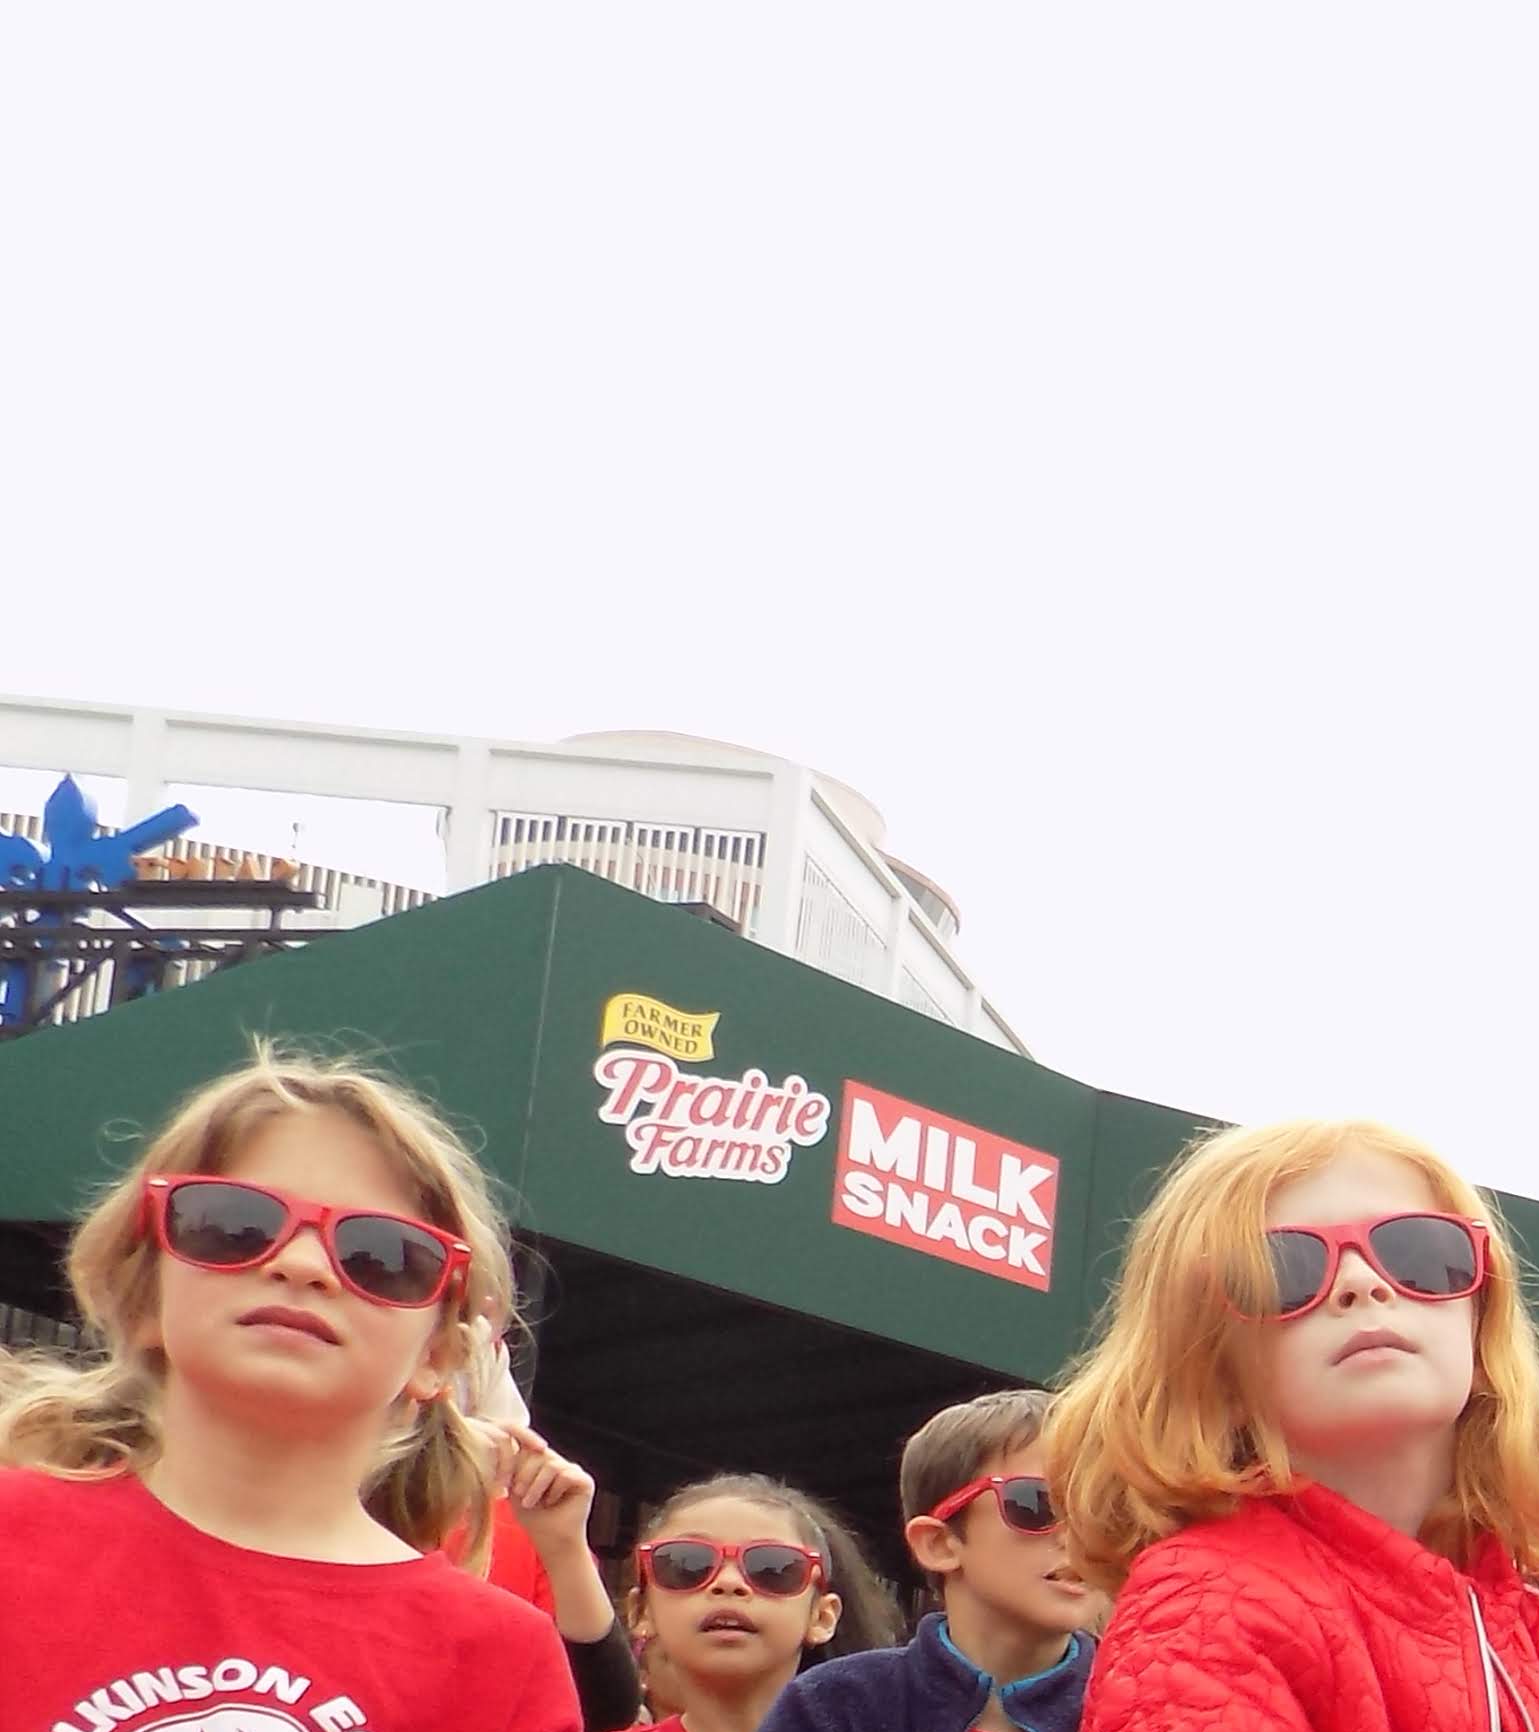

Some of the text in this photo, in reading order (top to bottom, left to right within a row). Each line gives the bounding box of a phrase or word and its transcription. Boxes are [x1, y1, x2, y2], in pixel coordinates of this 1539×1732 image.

[621, 1000, 703, 1039] FARMER
[624, 1018, 698, 1056] OWNED
[598, 1054, 826, 1140] Prairie
[635, 1122, 787, 1176] Farms
[848, 1096, 1052, 1231] MILK
[840, 1171, 1048, 1277] SNACK
